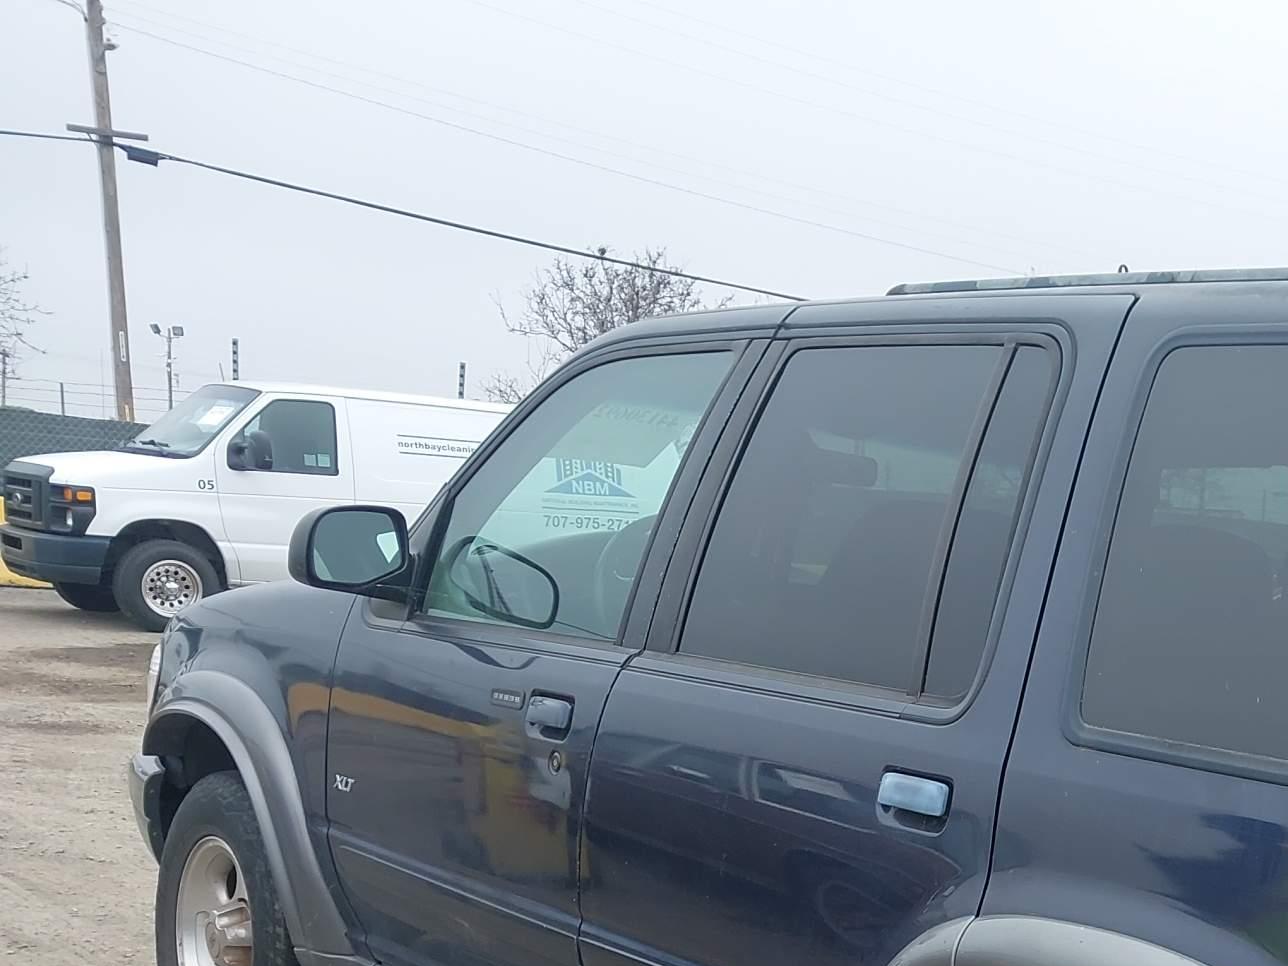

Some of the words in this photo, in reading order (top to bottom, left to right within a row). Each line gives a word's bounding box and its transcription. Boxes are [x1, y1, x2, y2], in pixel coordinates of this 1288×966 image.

[198, 479, 215, 490] 05
[571, 480, 610, 496] NBM
[543, 514, 632, 531] 707-975-27
[333, 774, 355, 792] XLT
